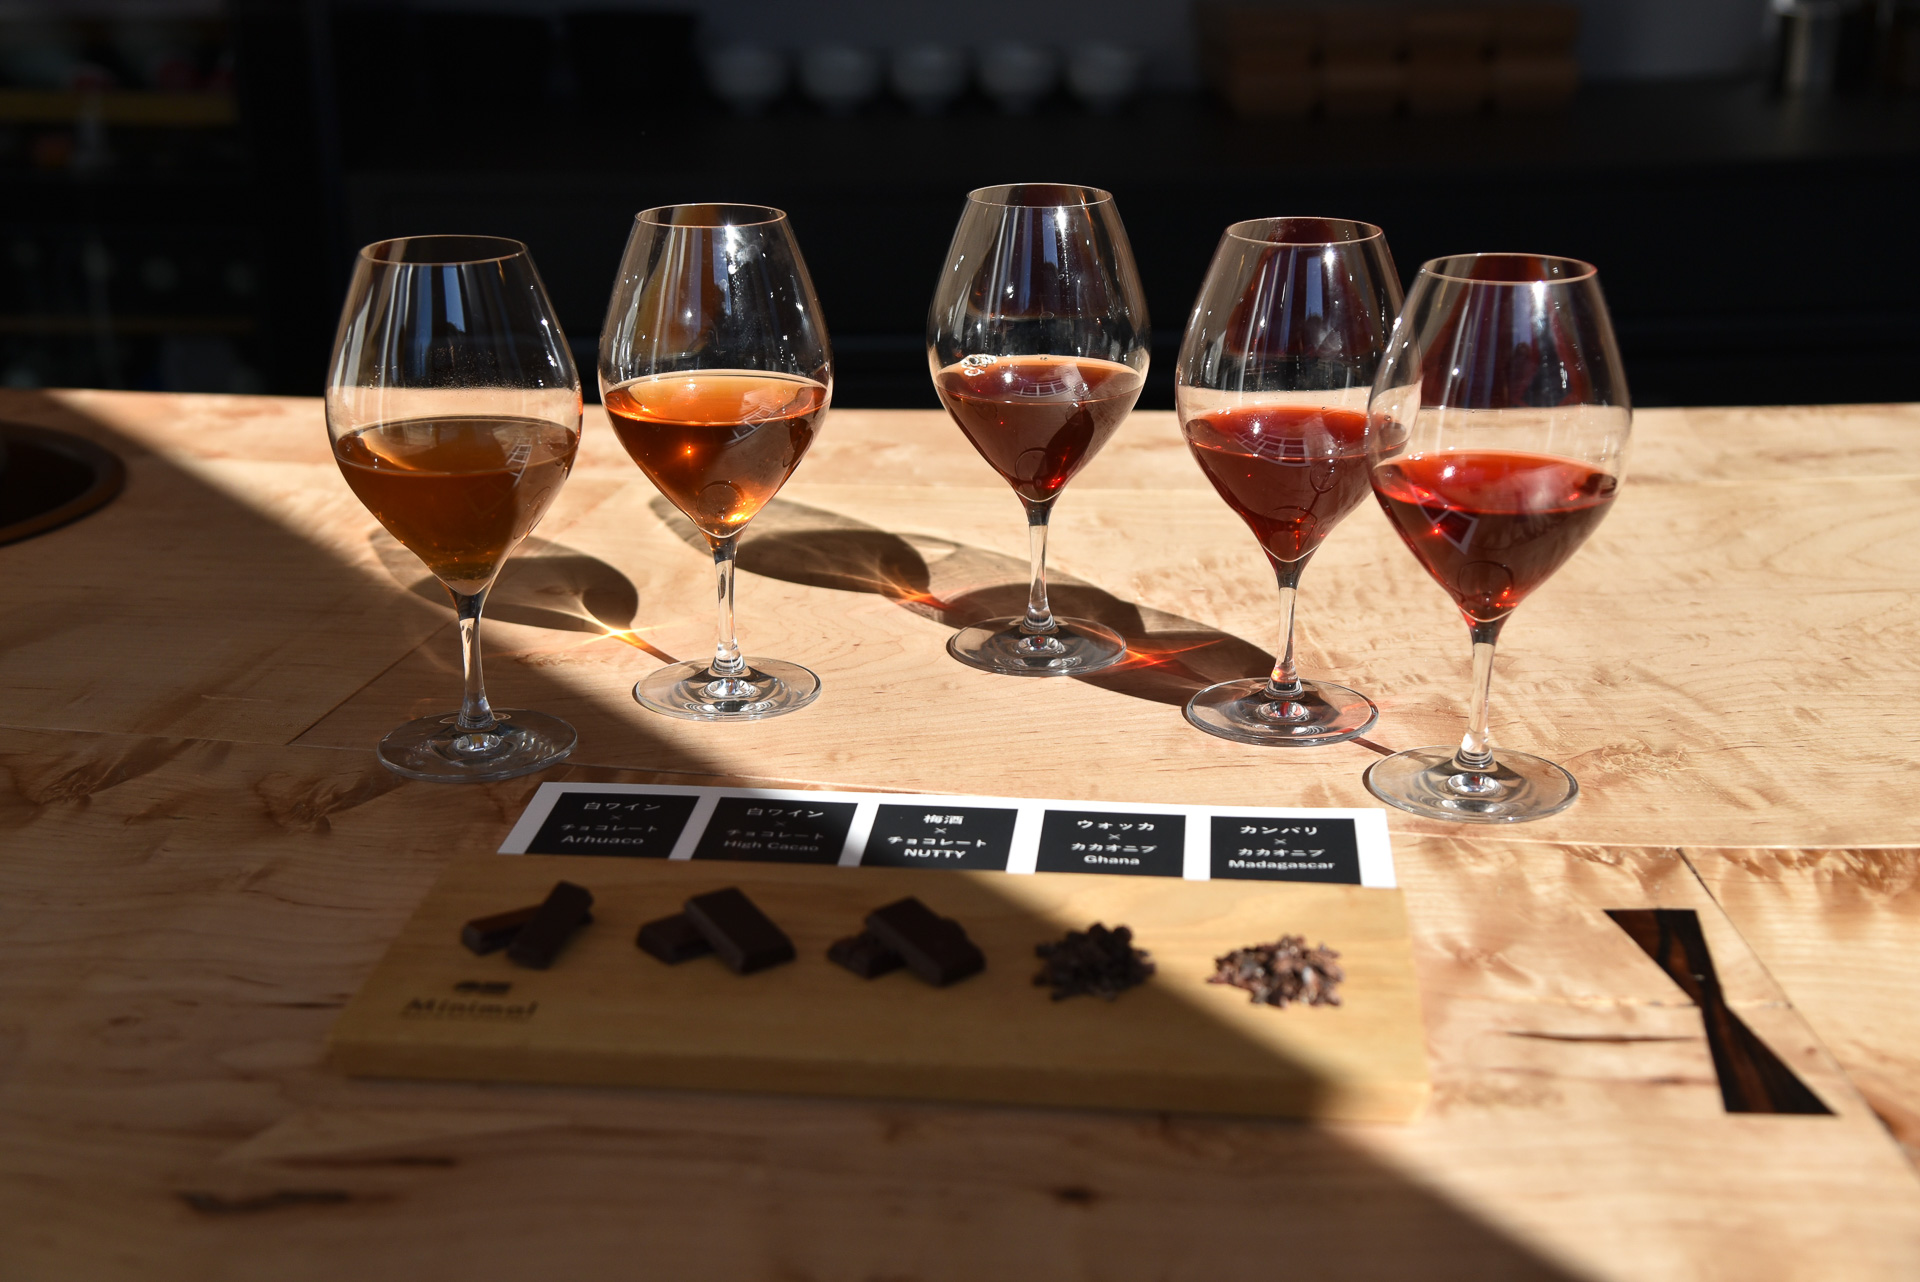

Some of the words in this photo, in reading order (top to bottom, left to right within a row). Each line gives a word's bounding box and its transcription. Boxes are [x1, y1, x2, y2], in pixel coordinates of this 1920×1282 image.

[923, 814, 964, 825] 梅酒
[561, 835, 644, 844] Arhuaco
[887, 836, 987, 848] チョコレート
[724, 840, 762, 850] High
[767, 842, 820, 852] Cacao
[904, 848, 966, 859] NUTTY
[1083, 854, 1140, 865] Ghana
[1228, 859, 1336, 870] Madagascar
